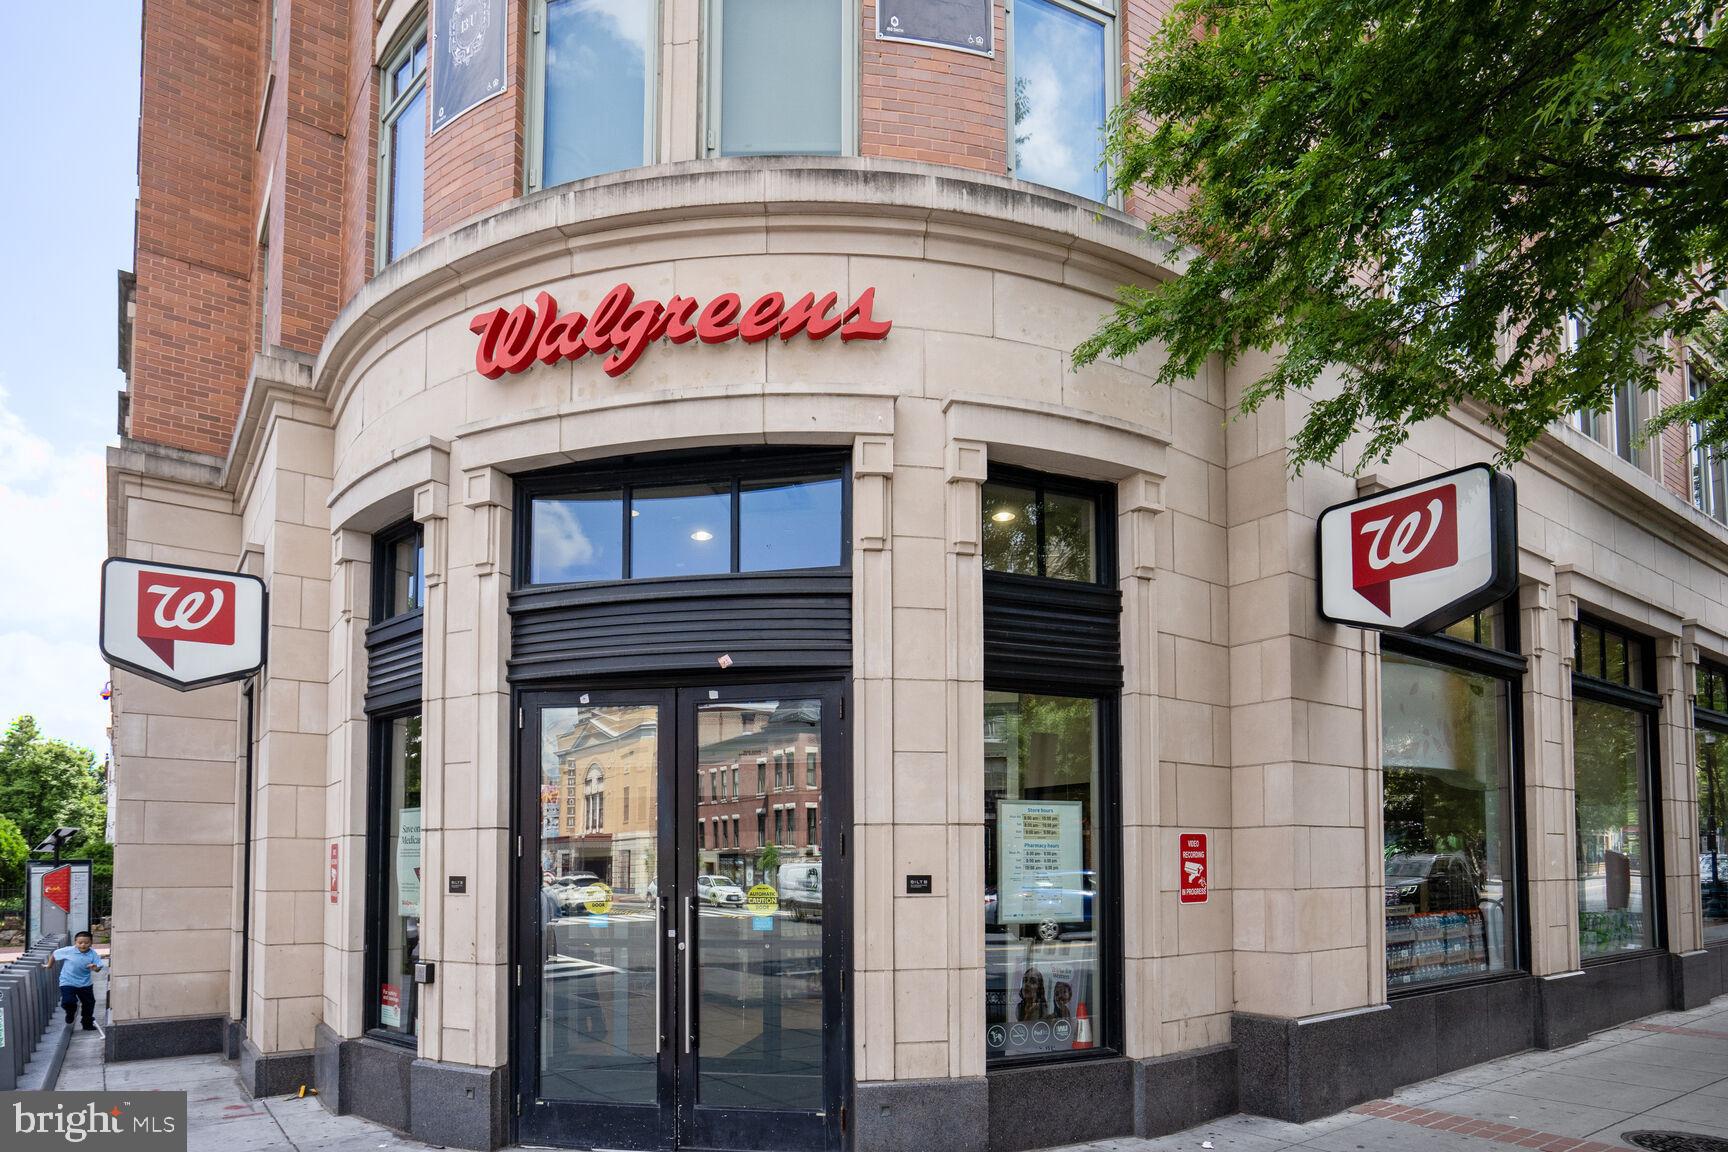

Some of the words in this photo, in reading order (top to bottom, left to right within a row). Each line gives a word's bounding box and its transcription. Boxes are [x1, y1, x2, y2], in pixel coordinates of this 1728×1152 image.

[469, 282, 893, 380] Walgreens
[1360, 498, 1443, 570] W
[147, 584, 225, 631] W
[402, 825, 412, 834] Save
[1187, 840, 1200, 848] VIDEO
[1182, 851, 1205, 859] RECORDING
[1182, 888, 1186, 896] IN
[1186, 887, 1206, 896] PROGRESS
